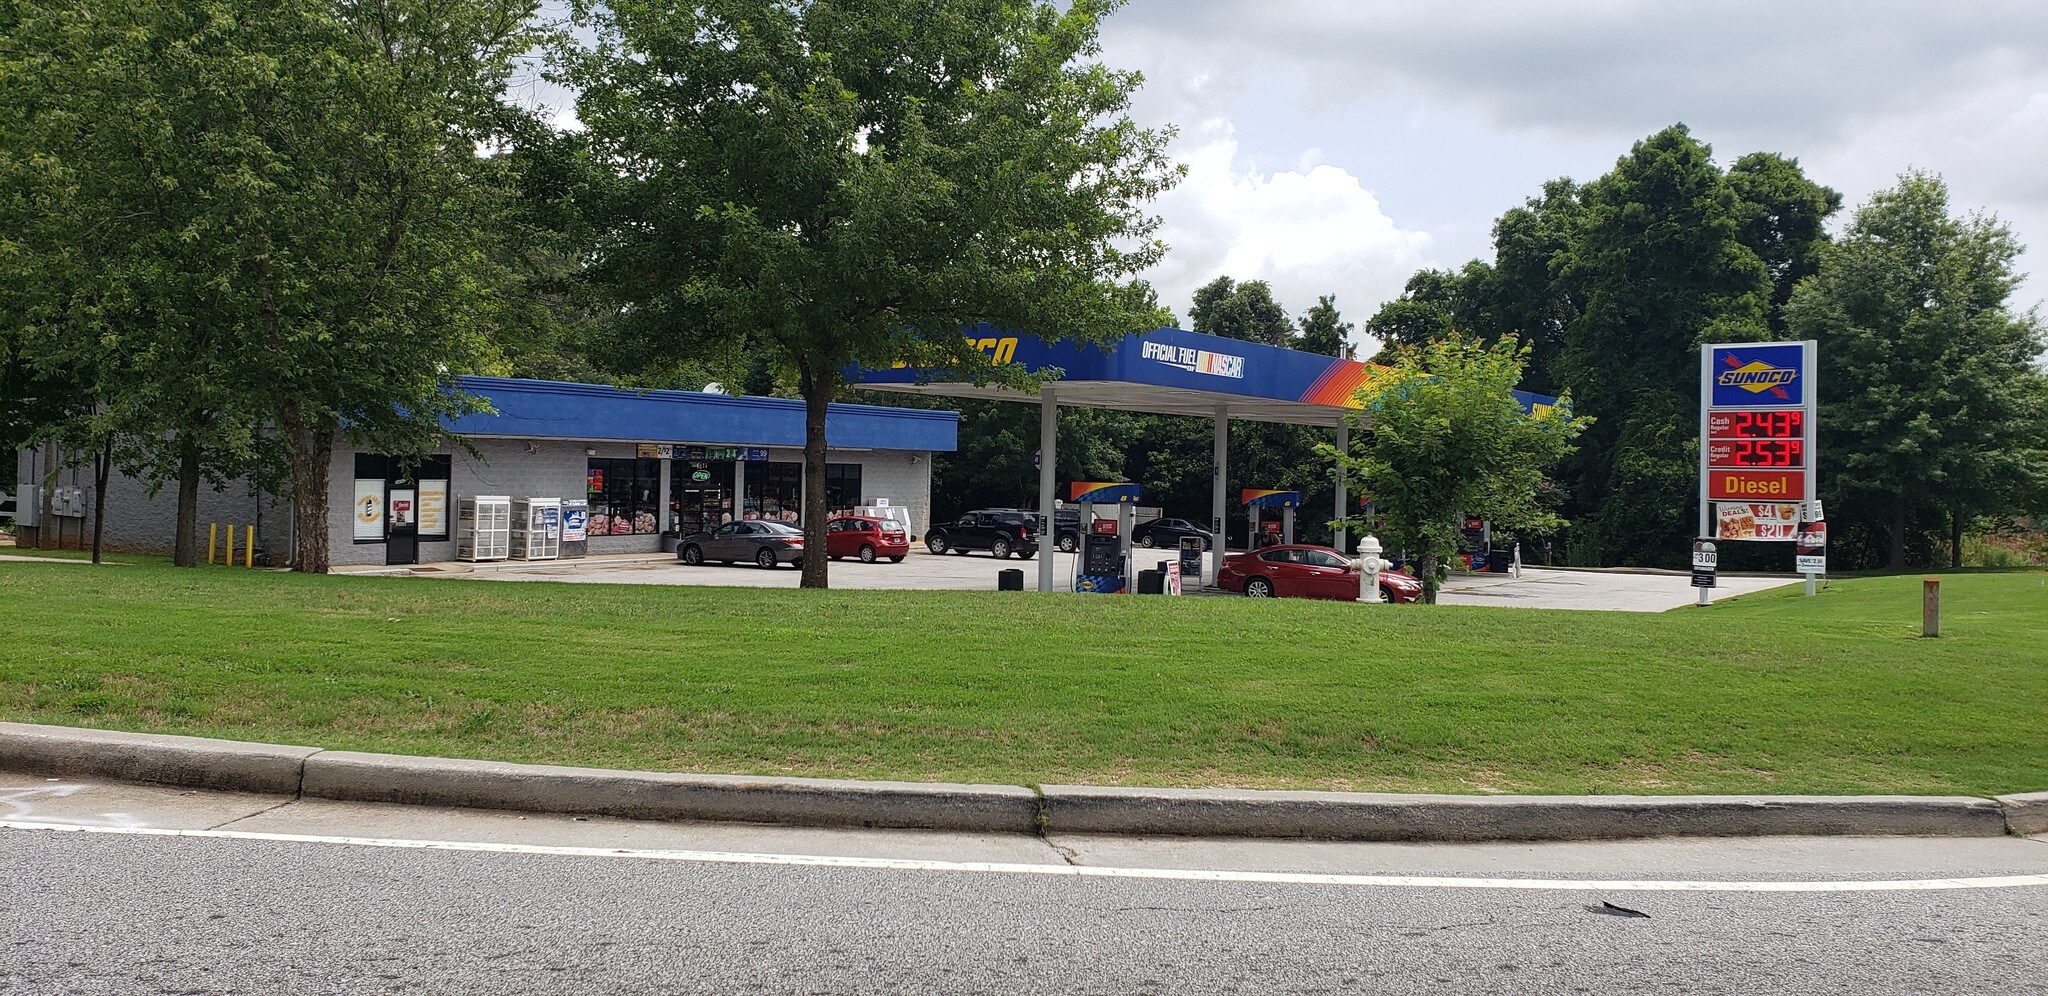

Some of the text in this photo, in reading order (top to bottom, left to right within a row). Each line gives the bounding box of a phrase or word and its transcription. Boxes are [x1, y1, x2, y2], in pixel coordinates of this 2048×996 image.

[1142, 341, 1197, 365] OFFICIAL FUEL
[1212, 352, 1242, 377] NASCAR
[1720, 370, 1794, 384] SUNOCO
[1710, 417, 1730, 425] Cash
[693, 472, 709, 480] OPEN
[1725, 476, 1787, 494] Diesel
[1761, 524, 1784, 537] $20
